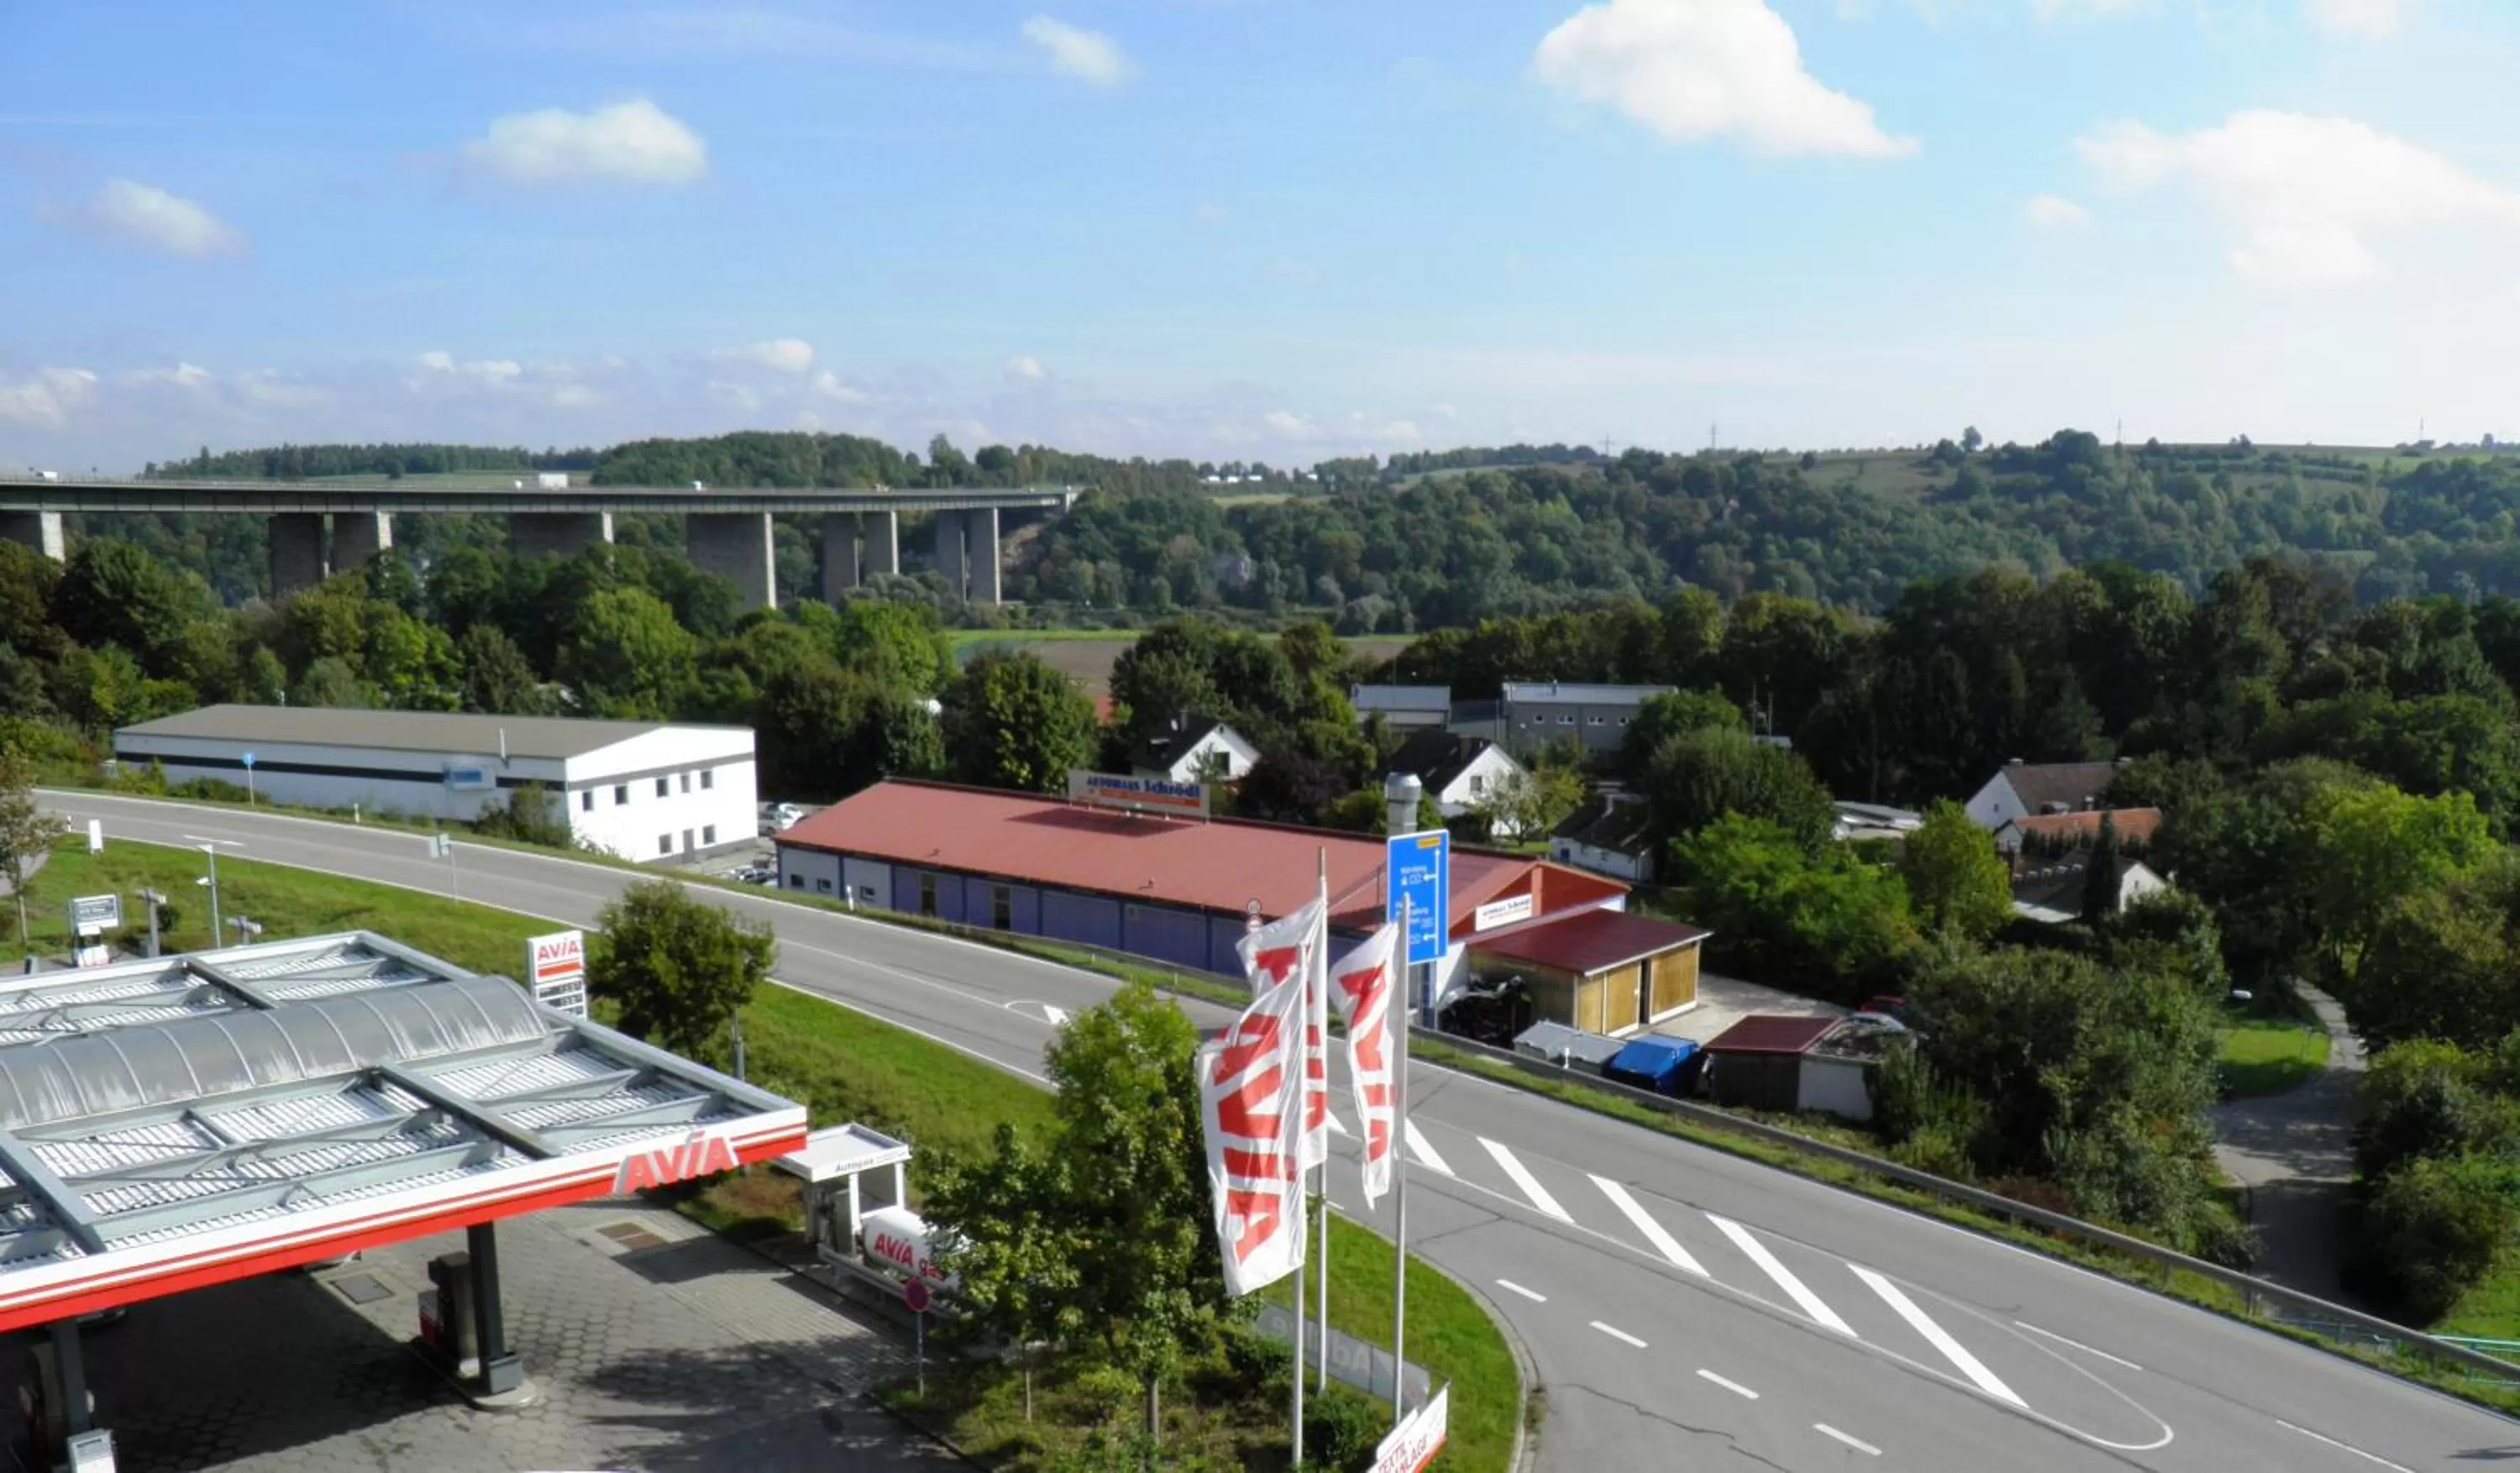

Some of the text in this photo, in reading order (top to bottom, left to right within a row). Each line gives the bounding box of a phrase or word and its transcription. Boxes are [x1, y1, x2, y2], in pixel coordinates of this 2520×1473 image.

[538, 937, 579, 960] AVIA
[1339, 960, 1395, 1162] AVIA
[621, 1130, 733, 1194] AVIA
[1213, 1011, 1297, 1266] AVIA
[874, 1232, 914, 1267] AVIA
